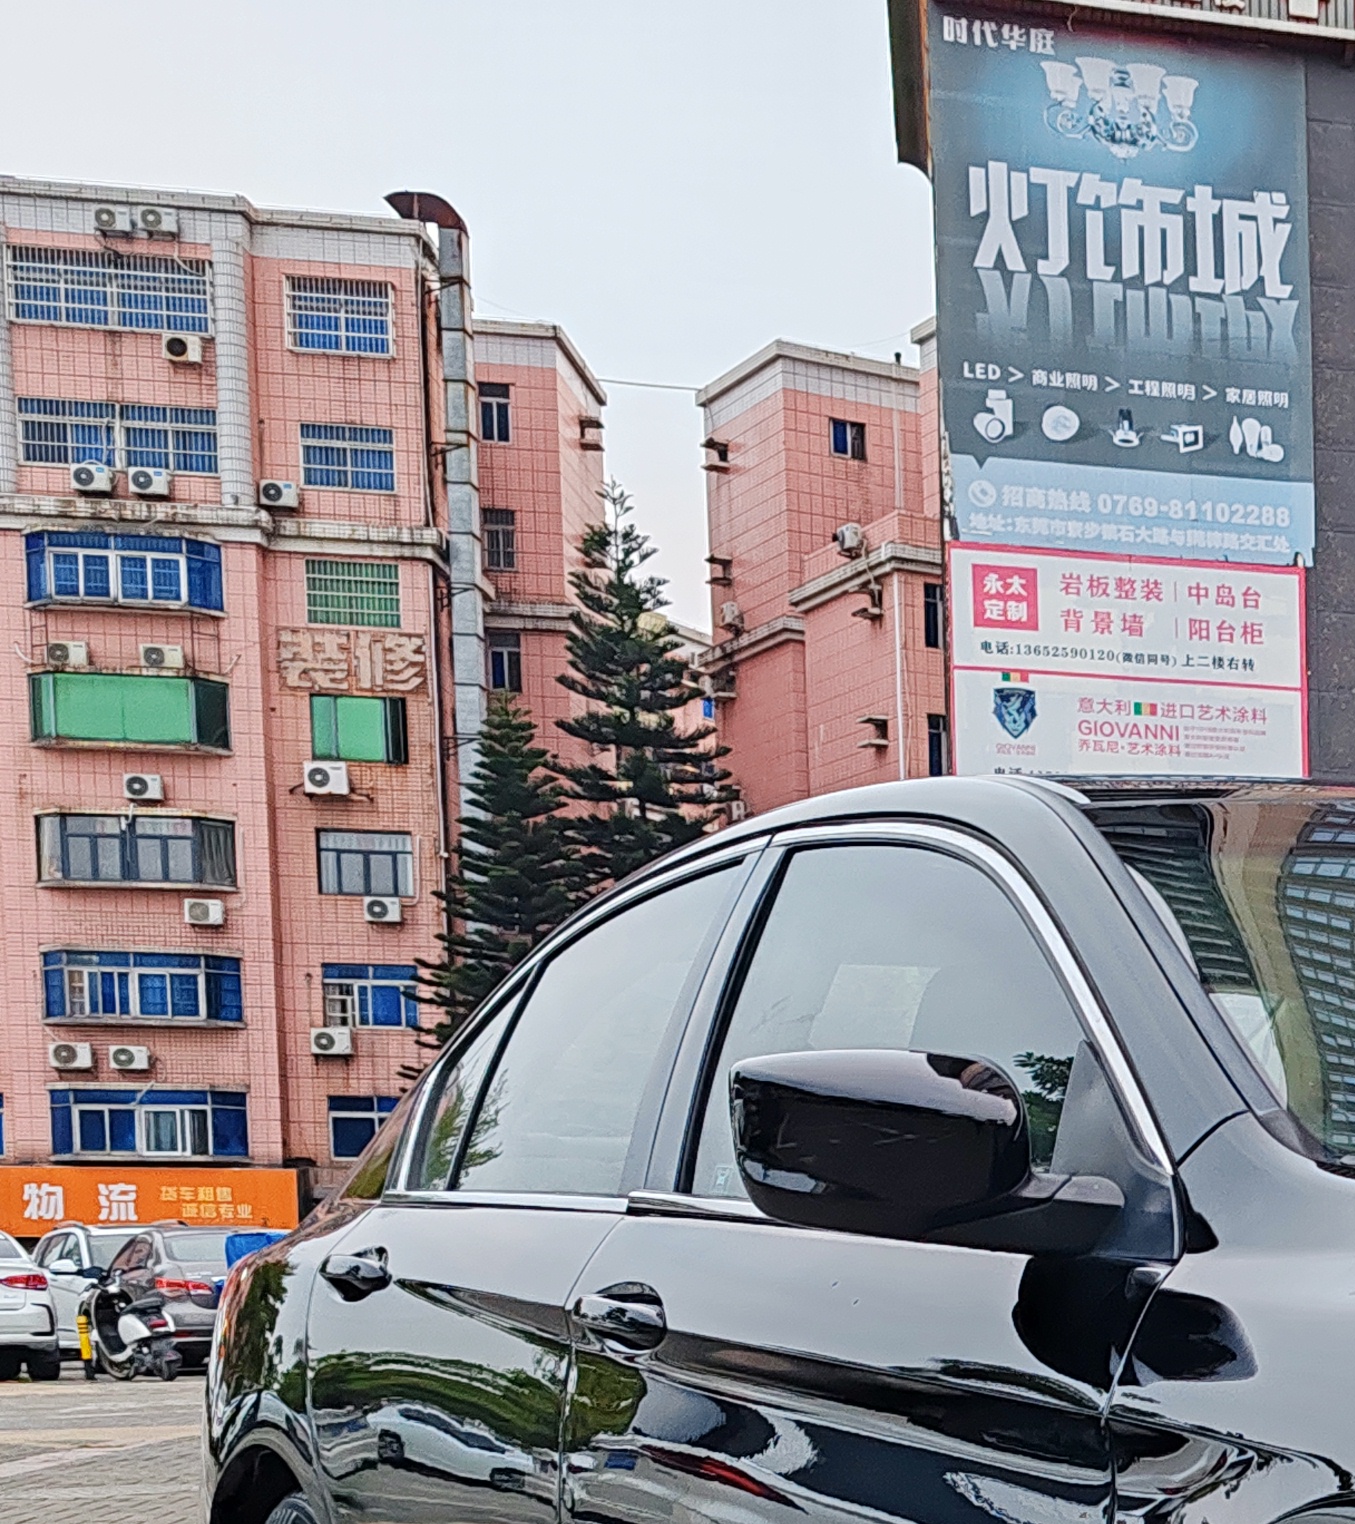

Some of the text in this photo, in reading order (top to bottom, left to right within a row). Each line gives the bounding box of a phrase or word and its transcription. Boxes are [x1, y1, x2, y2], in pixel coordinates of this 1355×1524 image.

[942, 15, 1056, 55] 时代华庭
[968, 160, 1293, 299] 灯饰城
[963, 362, 1289, 409] LED 商业照明 工程照明 家居照明
[1001, 484, 1291, 527] 招商热线 0769-81102288
[983, 573, 1027, 596] 永太
[1059, 571, 1262, 610] 岩板整装 中岛台
[983, 600, 1027, 622] 定制
[1059, 608, 1264, 645] 背景墙 阳台柜
[279, 630, 428, 692] 装修
[1181, 654, 1255, 671] 上二楼右转
[1077, 697, 1268, 725] 意大利 进口艺术涂料
[1078, 720, 1179, 741] GIOVANNI
[23, 1183, 138, 1222] 物流
